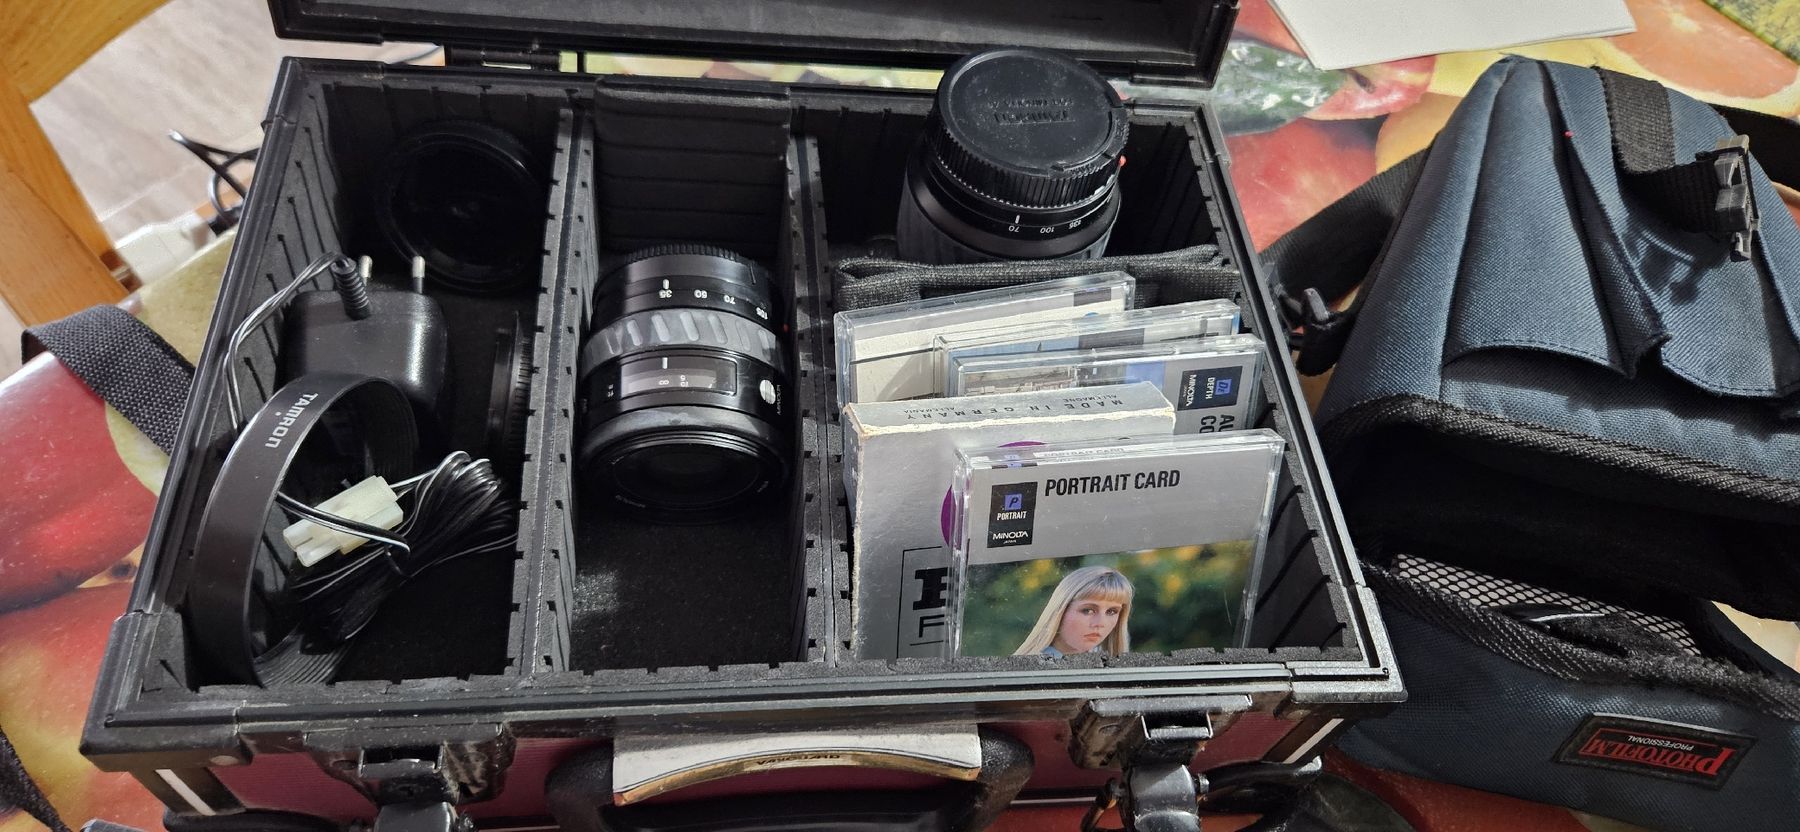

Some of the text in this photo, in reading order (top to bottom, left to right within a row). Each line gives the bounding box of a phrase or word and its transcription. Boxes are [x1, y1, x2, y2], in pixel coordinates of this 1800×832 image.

[1008, 225, 1020, 233] 70
[1039, 226, 1055, 234] 100
[659, 289, 673, 299] 35
[723, 294, 736, 305] 70
[1185, 374, 1197, 407] MINOLTA
[1205, 377, 1216, 400] DEPTH
[906, 399, 1124, 420] MADE IN GERMANY
[264, 392, 319, 449] TAMRON
[1044, 469, 1181, 497] PORTRAIT CARD
[996, 511, 1027, 521] PORTRAIT
[992, 530, 1029, 541] MINOLTA
[1627, 734, 1694, 751] PROFESSIONAL
[1586, 739, 1737, 775] PHOTOFILM
